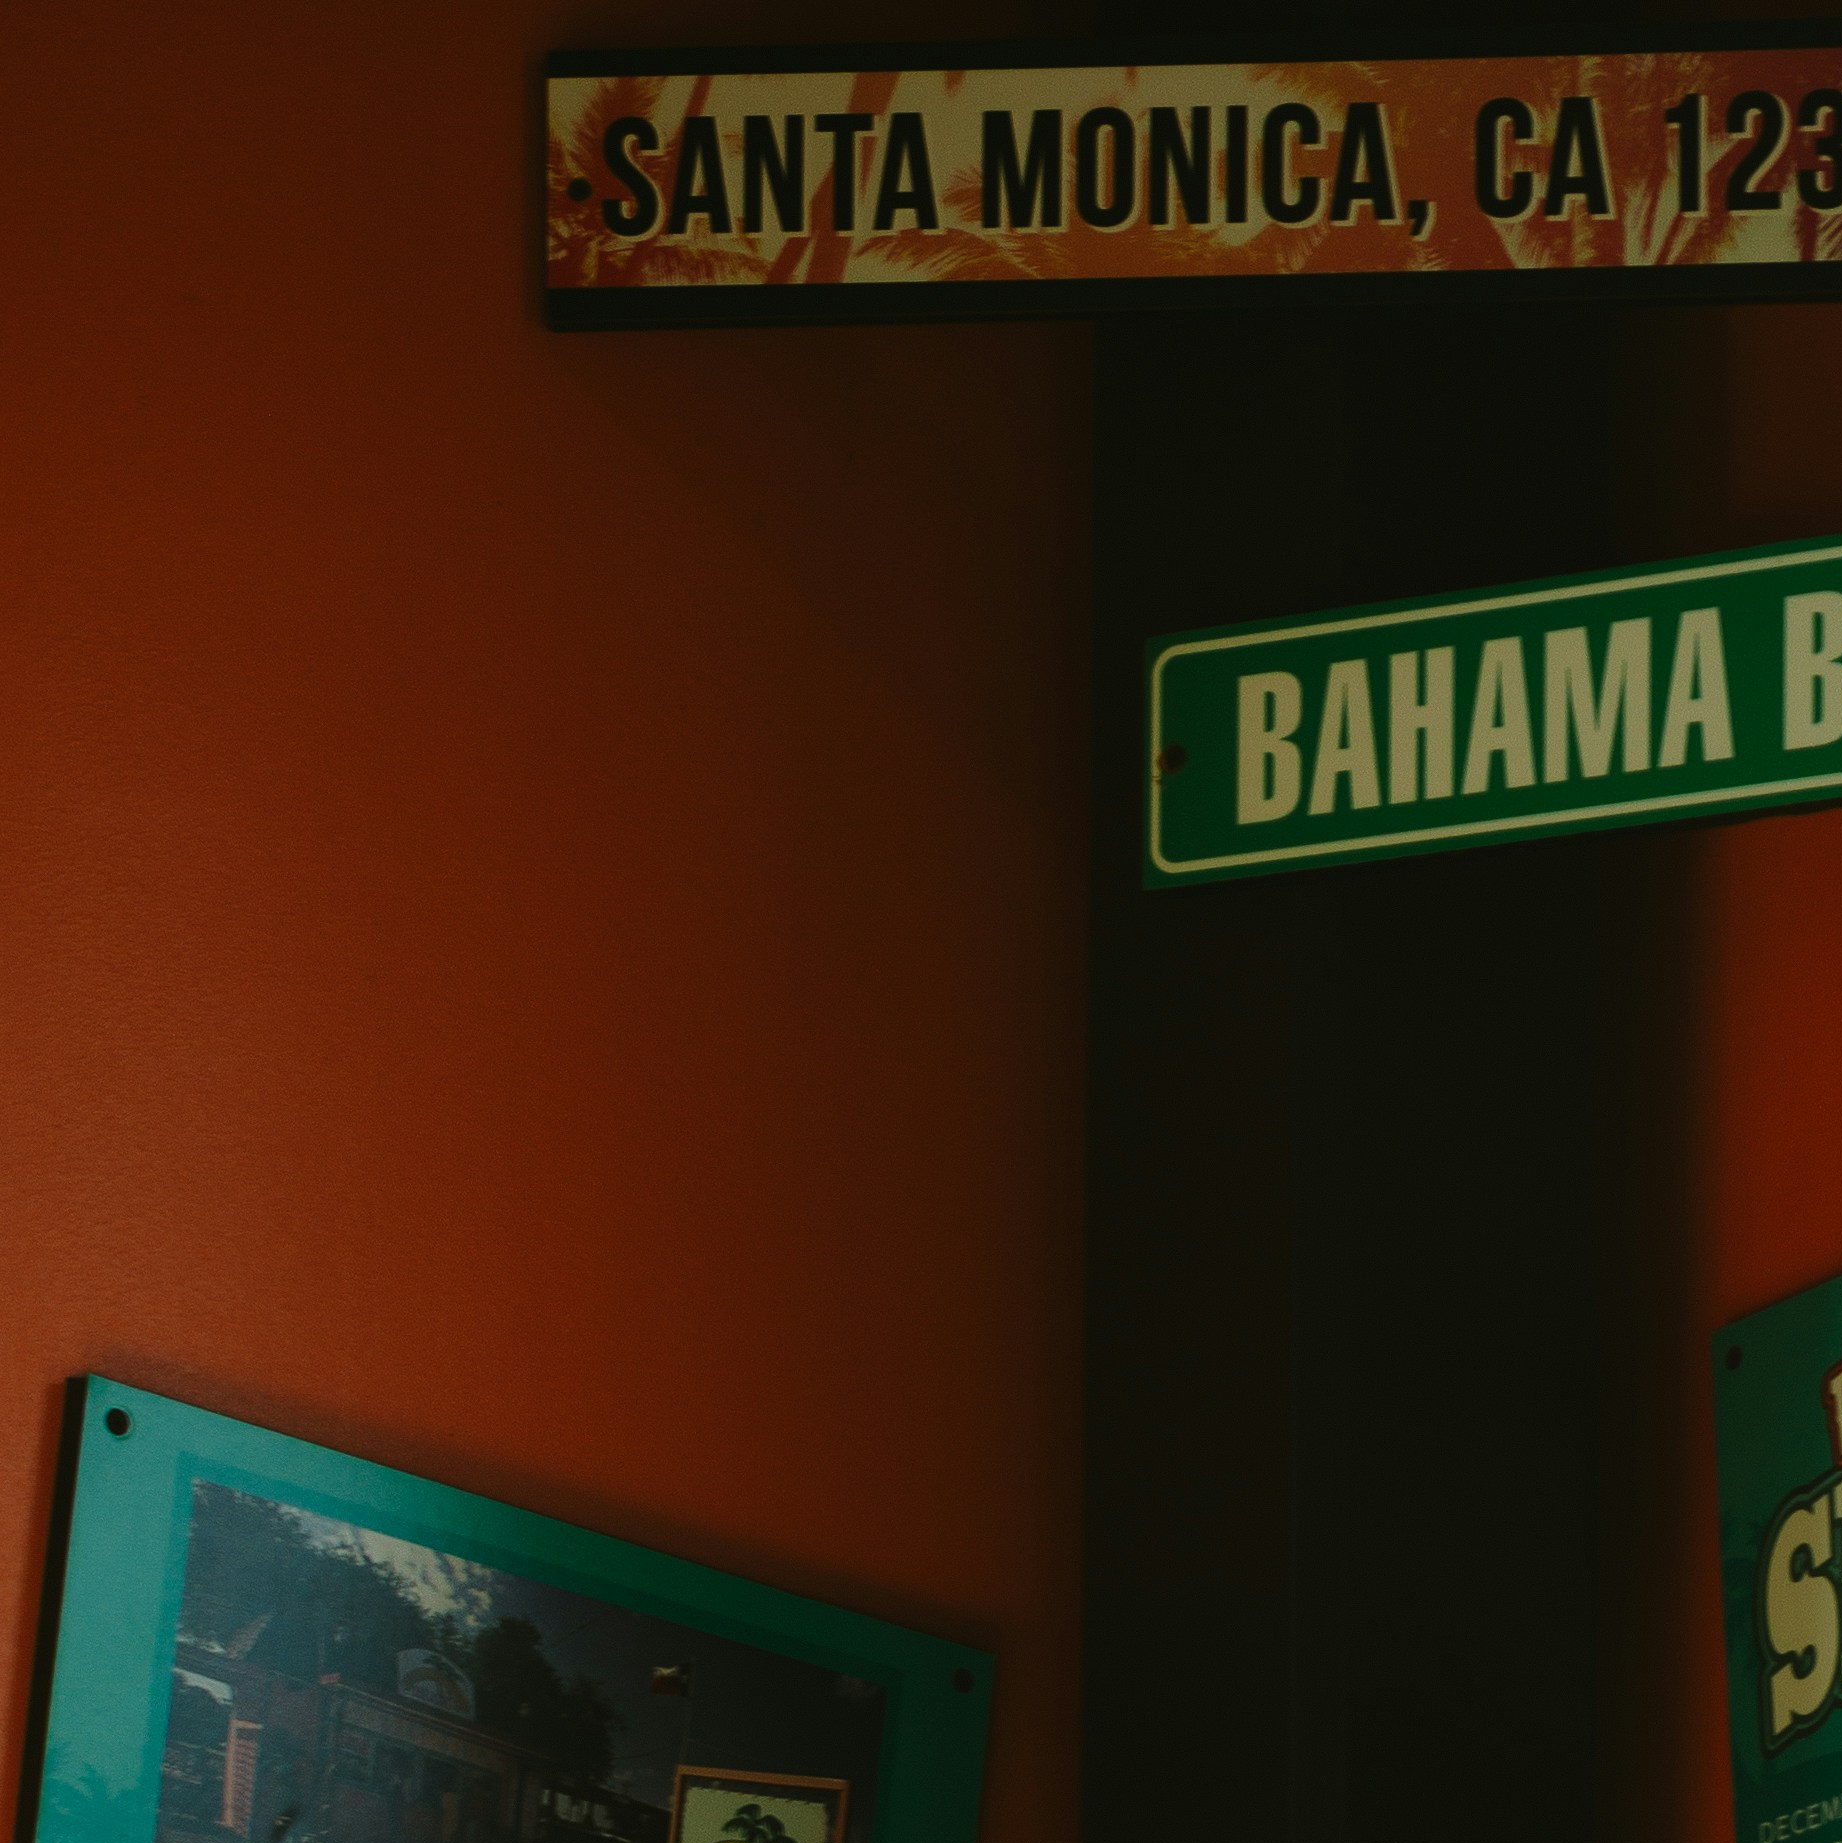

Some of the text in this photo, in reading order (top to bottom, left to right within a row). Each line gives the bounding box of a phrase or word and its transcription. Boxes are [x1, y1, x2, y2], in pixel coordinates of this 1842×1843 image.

[602, 111, 941, 237] SANTA
[981, 102, 1434, 238] MONICA,
[1475, 97, 1610, 220] CA
[1234, 605, 1737, 826] BAHAMA
